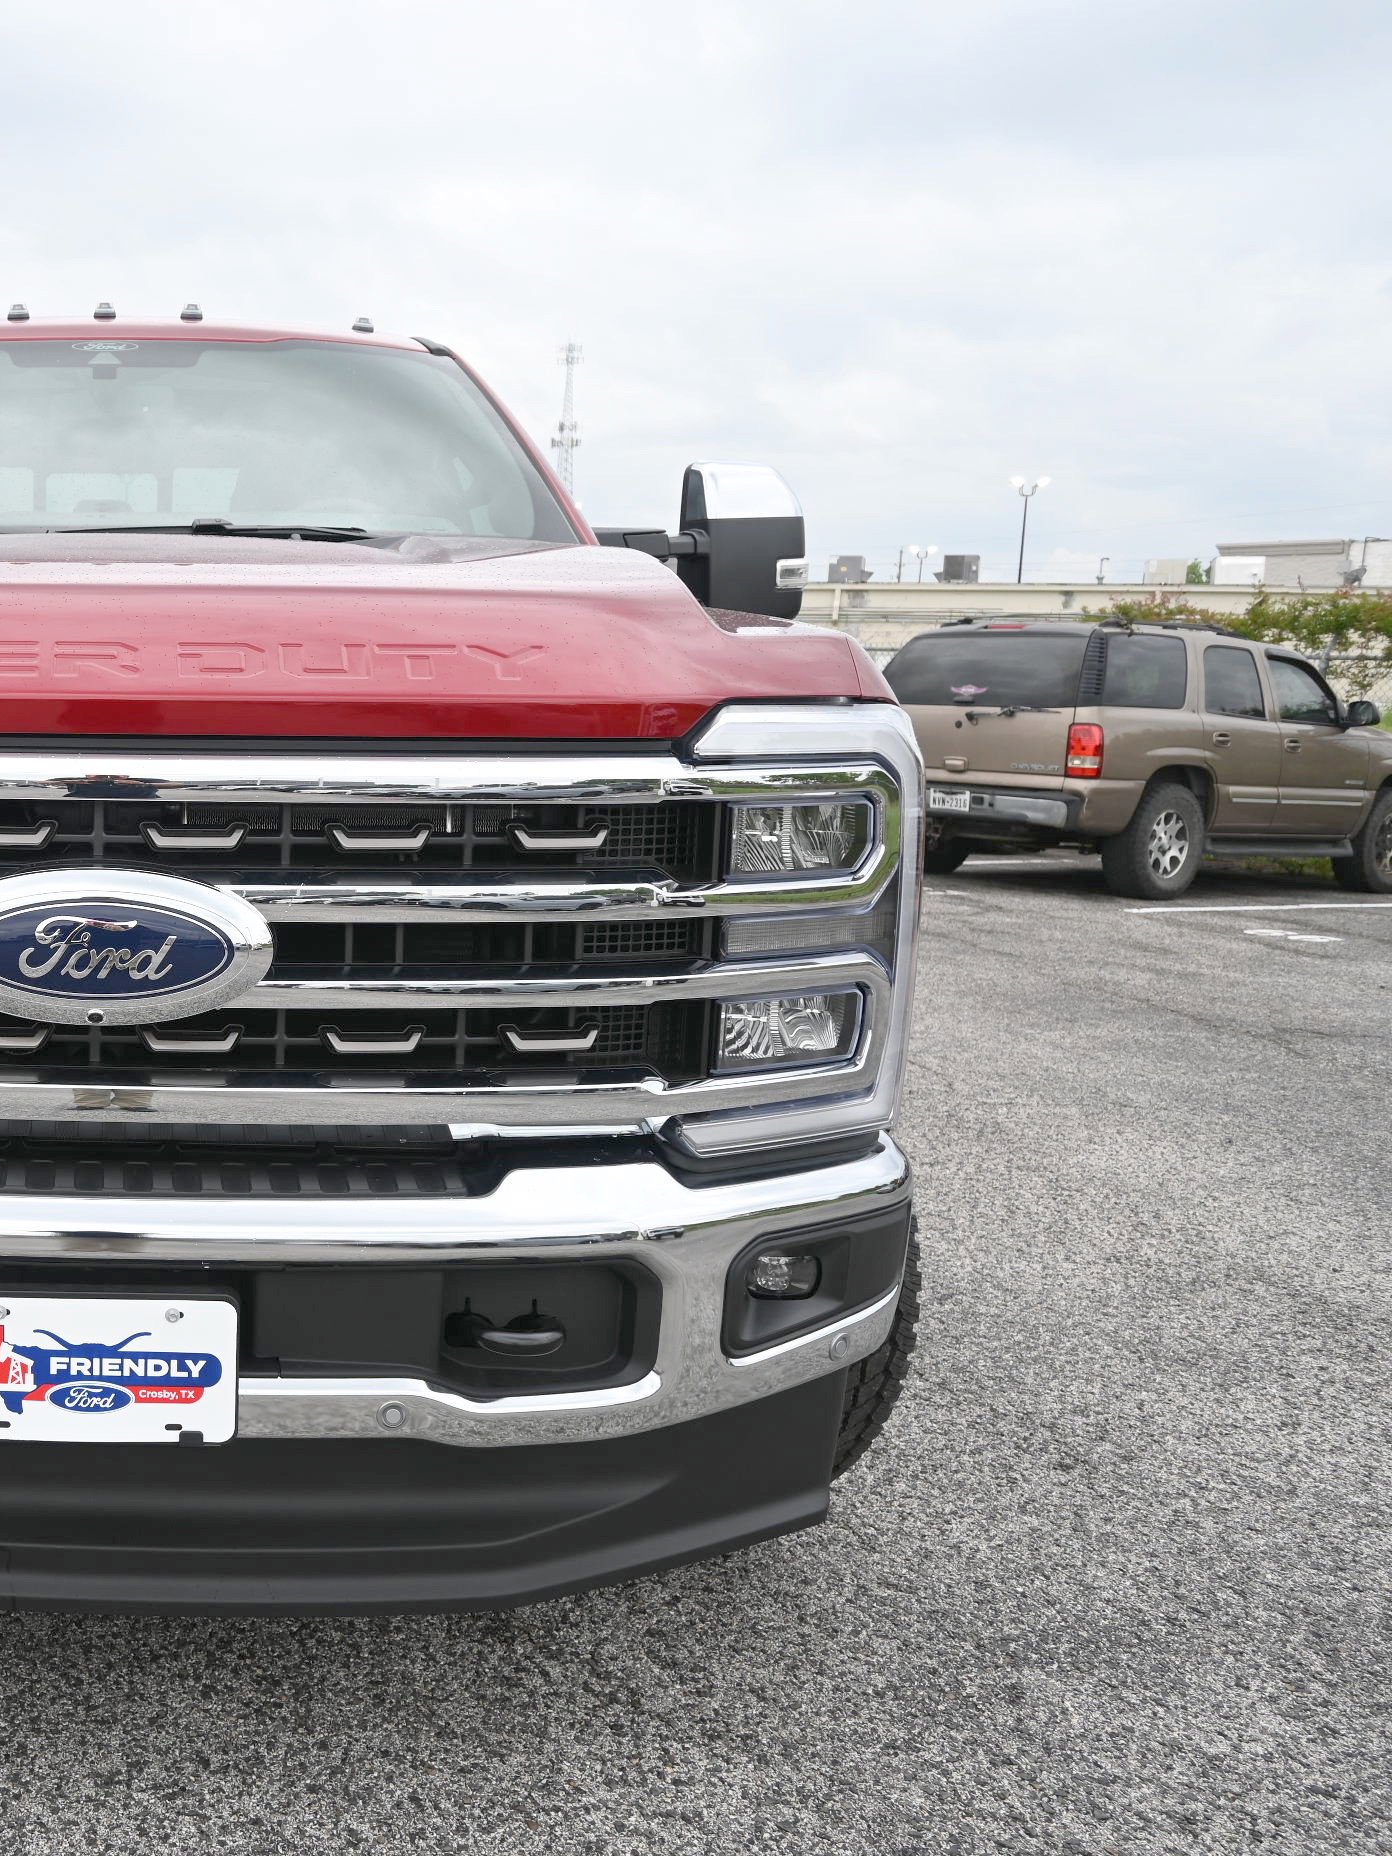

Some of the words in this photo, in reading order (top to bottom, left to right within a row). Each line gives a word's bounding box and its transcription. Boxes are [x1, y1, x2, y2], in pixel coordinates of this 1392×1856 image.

[83, 342, 127, 350] Ford
[177, 641, 546, 680] DUTY
[18, 915, 177, 980] Ford
[49, 1356, 207, 1378] FRIENDLY
[64, 1386, 116, 1408] Ford
[138, 1389, 179, 1400] Crosby,
[180, 1390, 196, 1399] TX
